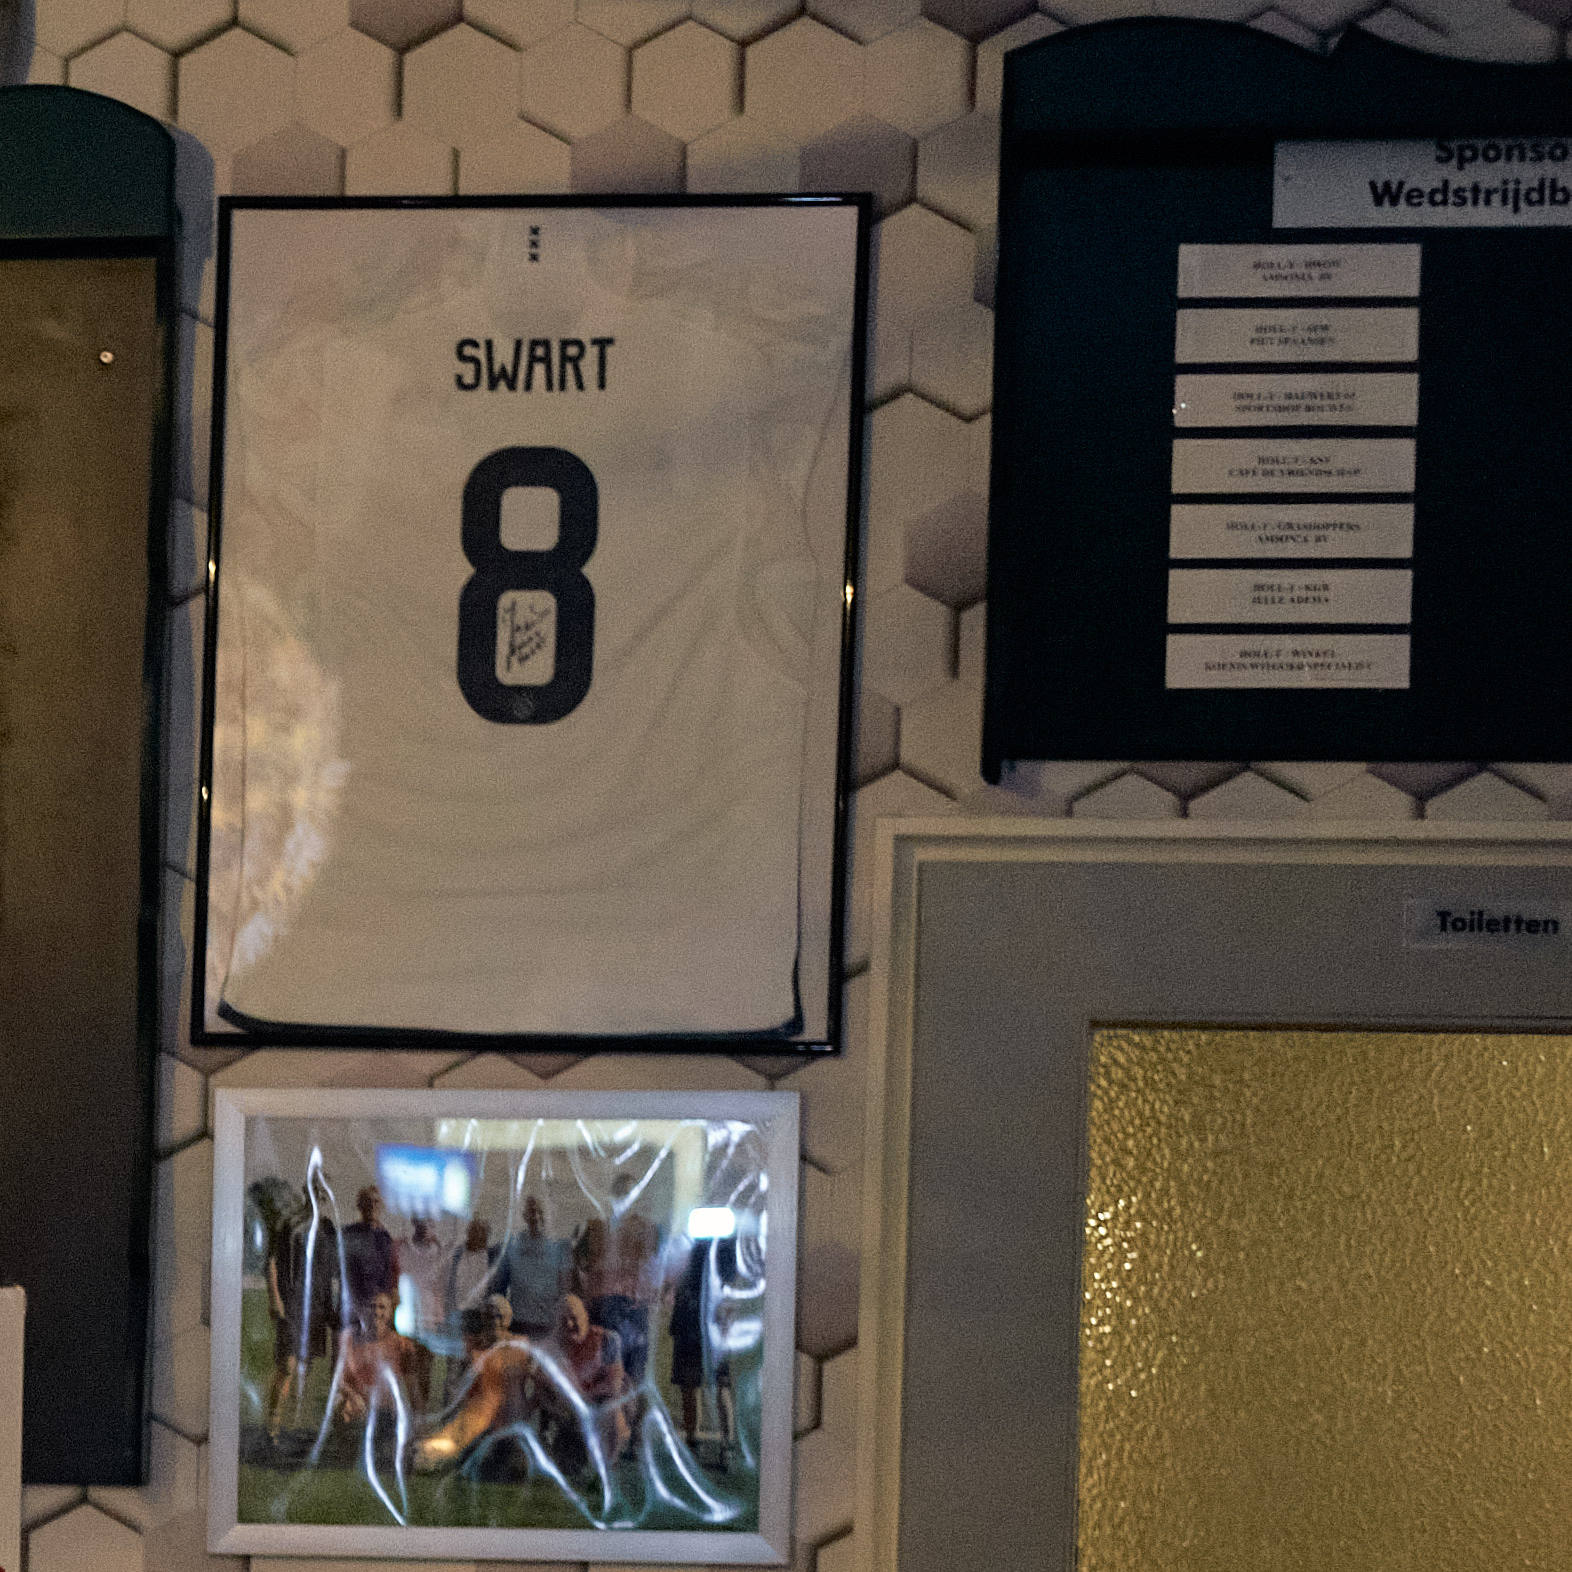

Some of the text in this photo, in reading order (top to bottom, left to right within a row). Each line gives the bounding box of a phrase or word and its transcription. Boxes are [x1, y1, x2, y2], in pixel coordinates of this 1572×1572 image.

[1368, 177, 1572, 214] Wedstrijdb
[455, 337, 615, 392] SWART
[456, 446, 599, 725] 8
[1436, 910, 1560, 935] Toiletten
